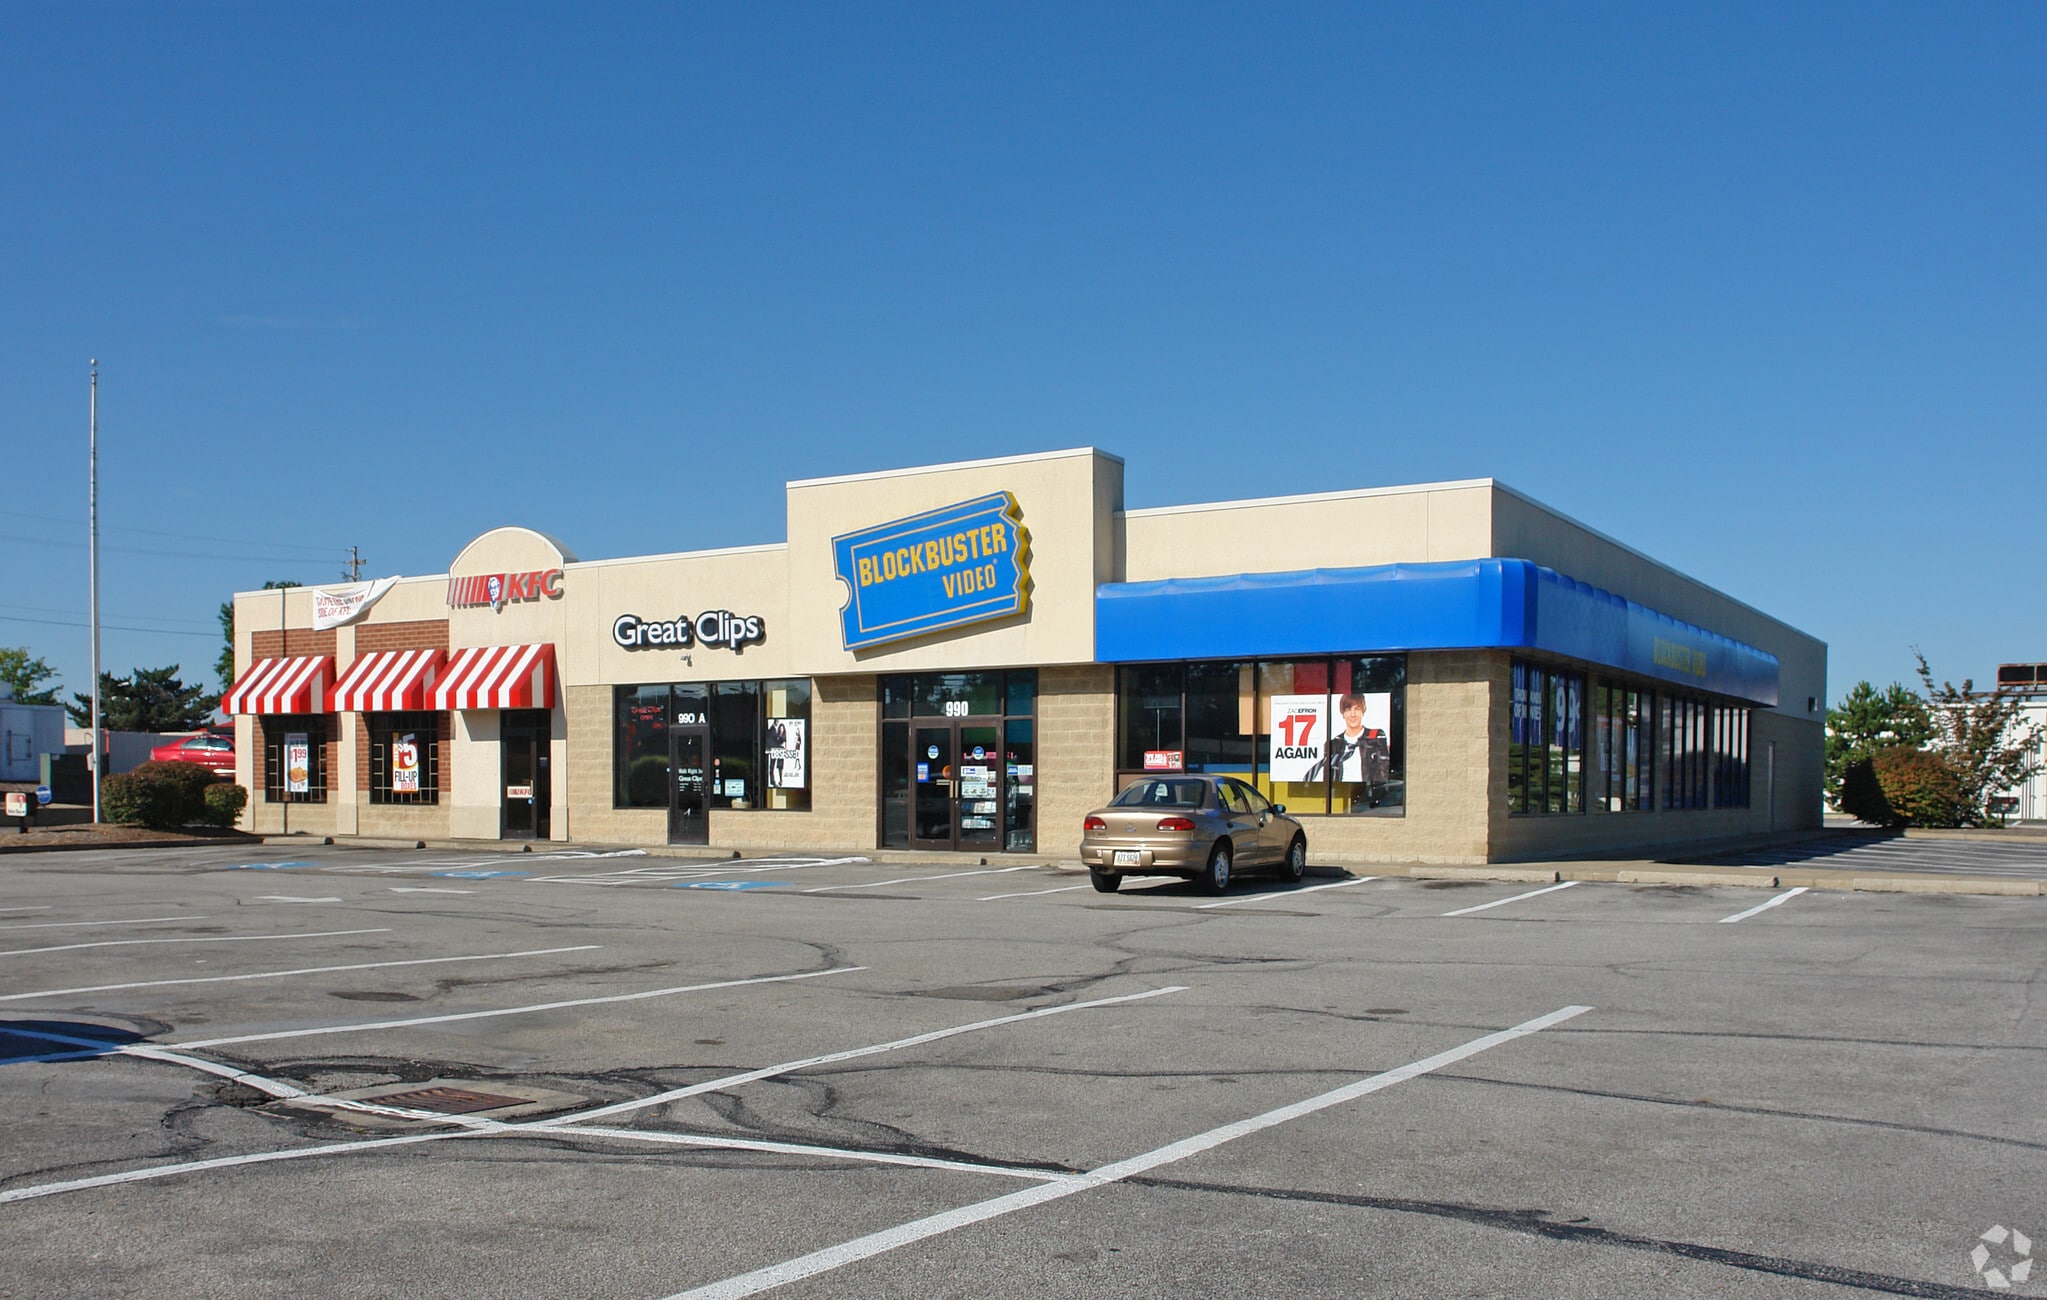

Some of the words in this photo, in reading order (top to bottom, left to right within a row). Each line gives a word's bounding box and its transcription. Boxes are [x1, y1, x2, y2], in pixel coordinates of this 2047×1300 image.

[859, 523, 1007, 587] BLOCKBUSTER
[507, 569, 558, 599] KFC
[942, 564, 996, 598] VIDEO
[614, 615, 688, 646] Great
[695, 610, 759, 648] Clips
[678, 713, 696, 724] 990
[698, 713, 706, 724] A
[945, 701, 969, 717] 990
[1279, 714, 1317, 747] 17
[1275, 747, 1318, 759] AGAIN
[395, 771, 417, 782] FILL-UP
